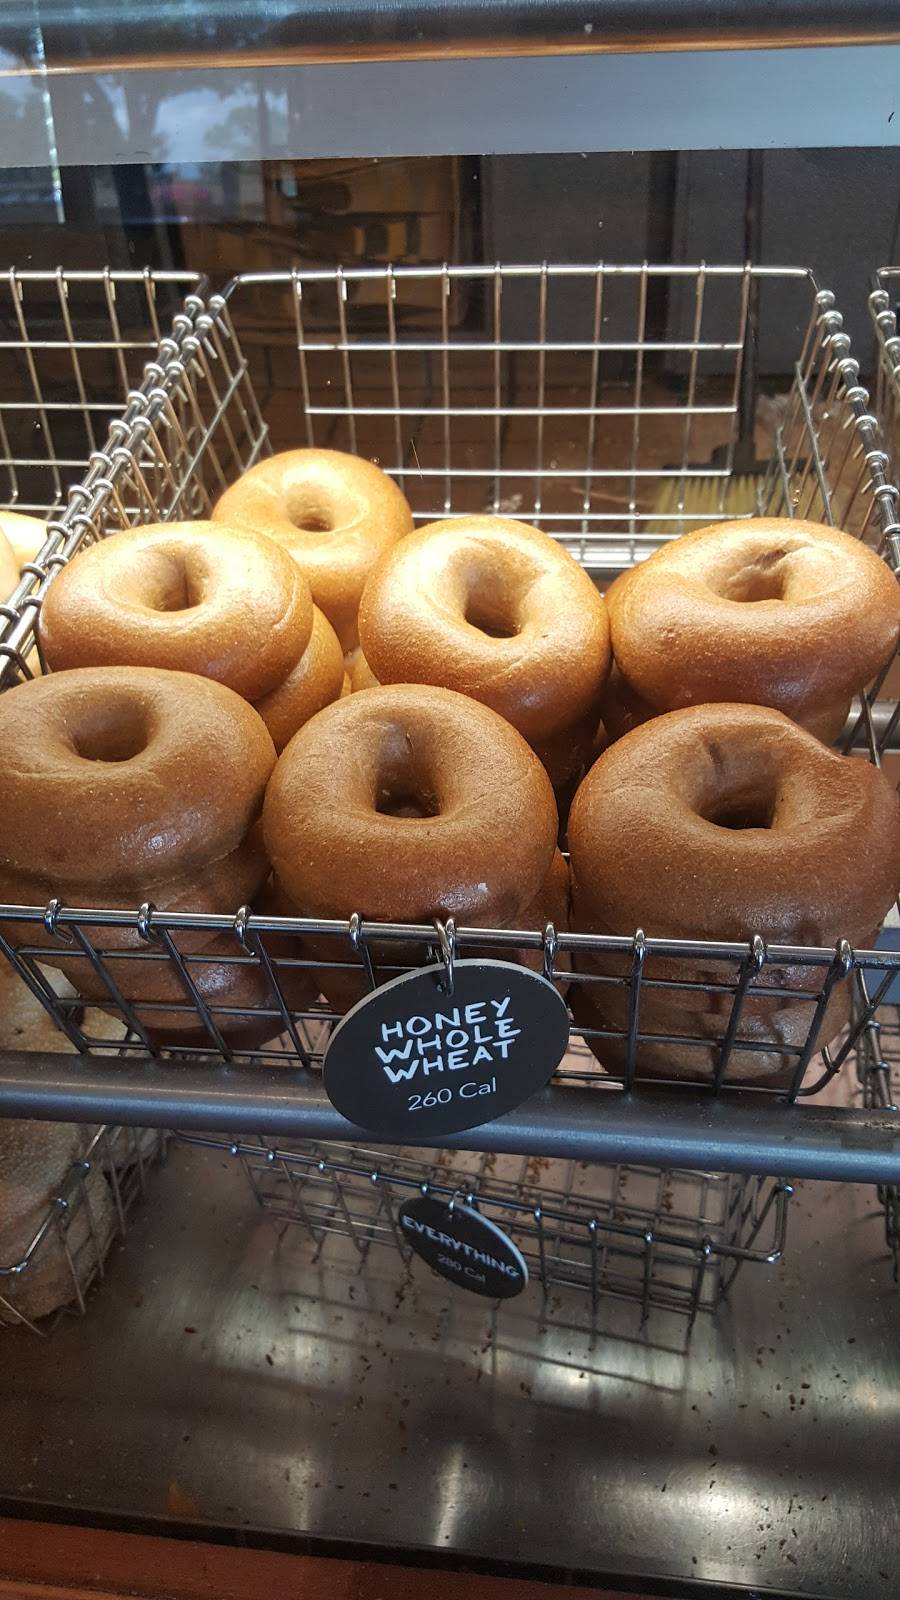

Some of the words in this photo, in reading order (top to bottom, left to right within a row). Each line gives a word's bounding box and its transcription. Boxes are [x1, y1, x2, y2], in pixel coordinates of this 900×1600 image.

[375, 1018, 521, 1064] WHOLE
[381, 997, 511, 1042] HONEY
[383, 1039, 515, 1083] WHEAT
[407, 1088, 452, 1111] 260
[459, 1077, 497, 1098] Cal
[402, 1215, 520, 1278] EVERYTHING
